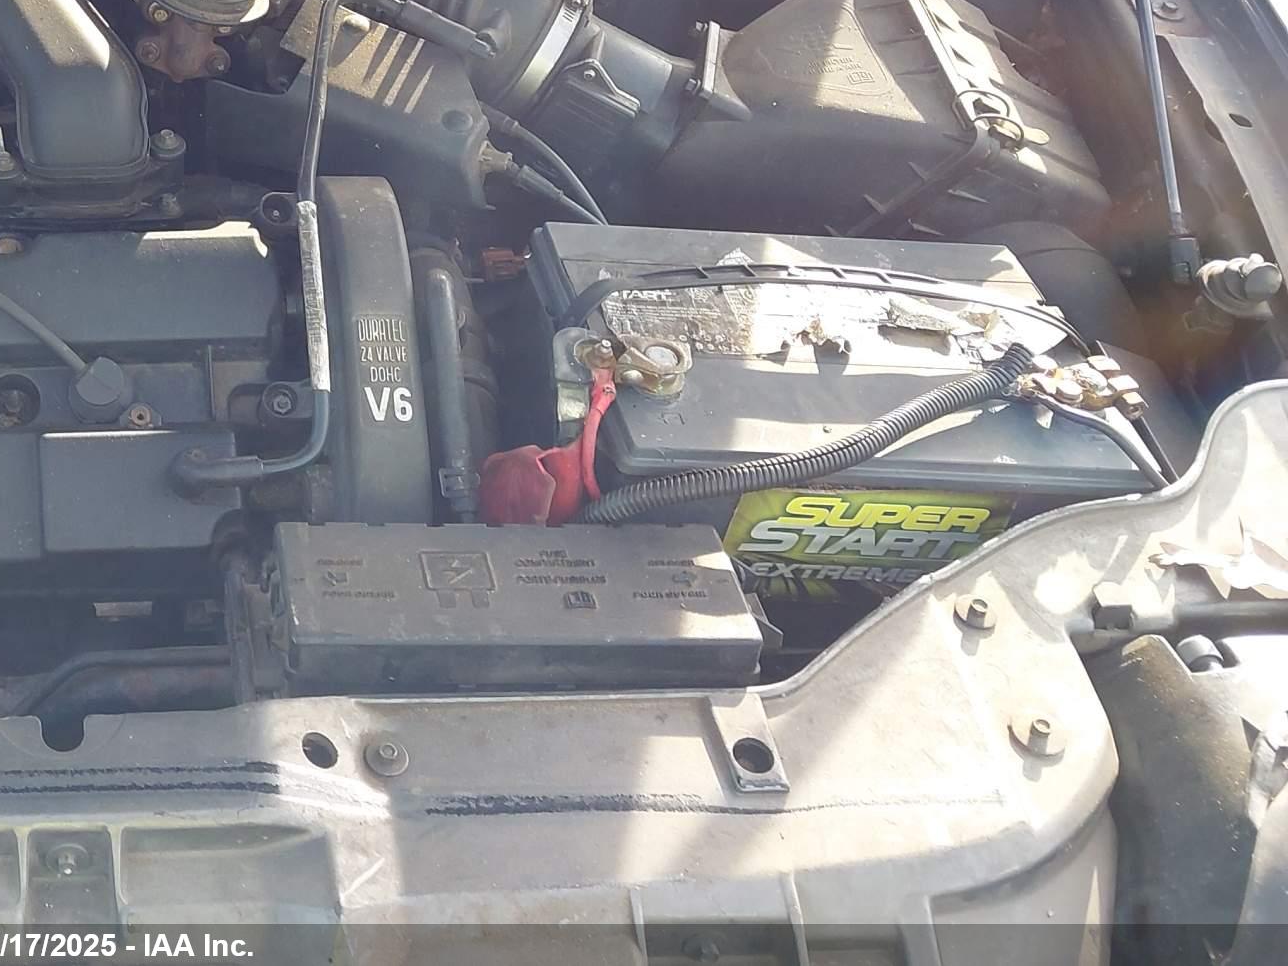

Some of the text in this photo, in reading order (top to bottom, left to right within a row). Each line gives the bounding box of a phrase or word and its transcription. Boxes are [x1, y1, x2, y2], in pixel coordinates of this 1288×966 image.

[358, 318, 407, 342] DURATEC
[360, 345, 408, 363] 24 VALVE
[370, 366, 402, 383] DOHC
[363, 386, 414, 422] V6
[778, 496, 991, 533] SUPER
[737, 520, 983, 560] START
[750, 561, 920, 583] EXTREME
